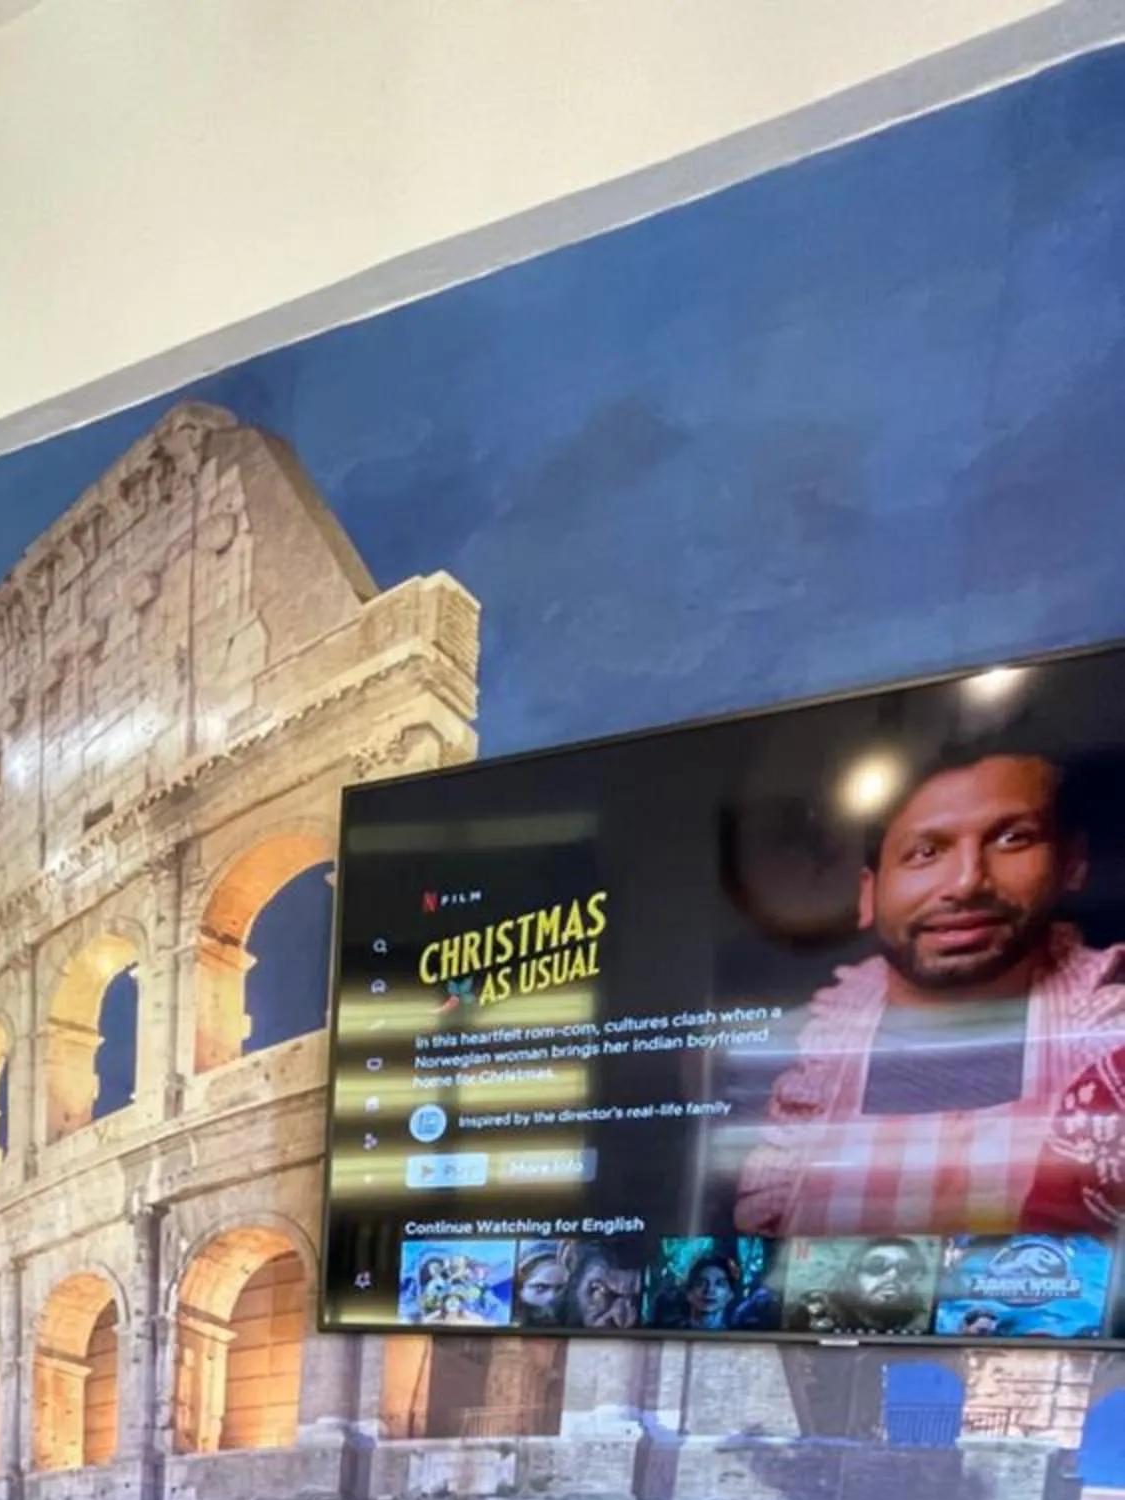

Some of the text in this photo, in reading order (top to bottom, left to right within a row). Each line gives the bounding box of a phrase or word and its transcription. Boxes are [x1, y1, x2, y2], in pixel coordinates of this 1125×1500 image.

[440, 889, 482, 907] FILM
[419, 891, 608, 985] CHRISTMAS
[479, 941, 601, 1007] AS USUAL
[415, 1034, 430, 1049] In
[432, 1033, 458, 1048] this
[461, 1028, 522, 1046] heartfelt
[604, 1014, 669, 1033] cultures
[672, 1009, 717, 1027] clash
[720, 1006, 767, 1022] when
[770, 1006, 782, 1019] a
[414, 1027, 769, 1069] Norwegian woman brings her Indian boyfriend
[412, 1074, 453, 1088] home
[456, 1072, 476, 1087] for
[458, 1100, 733, 1129] Inspired by the director's real-life family
[404, 1216, 646, 1236] Continue Watching for English
